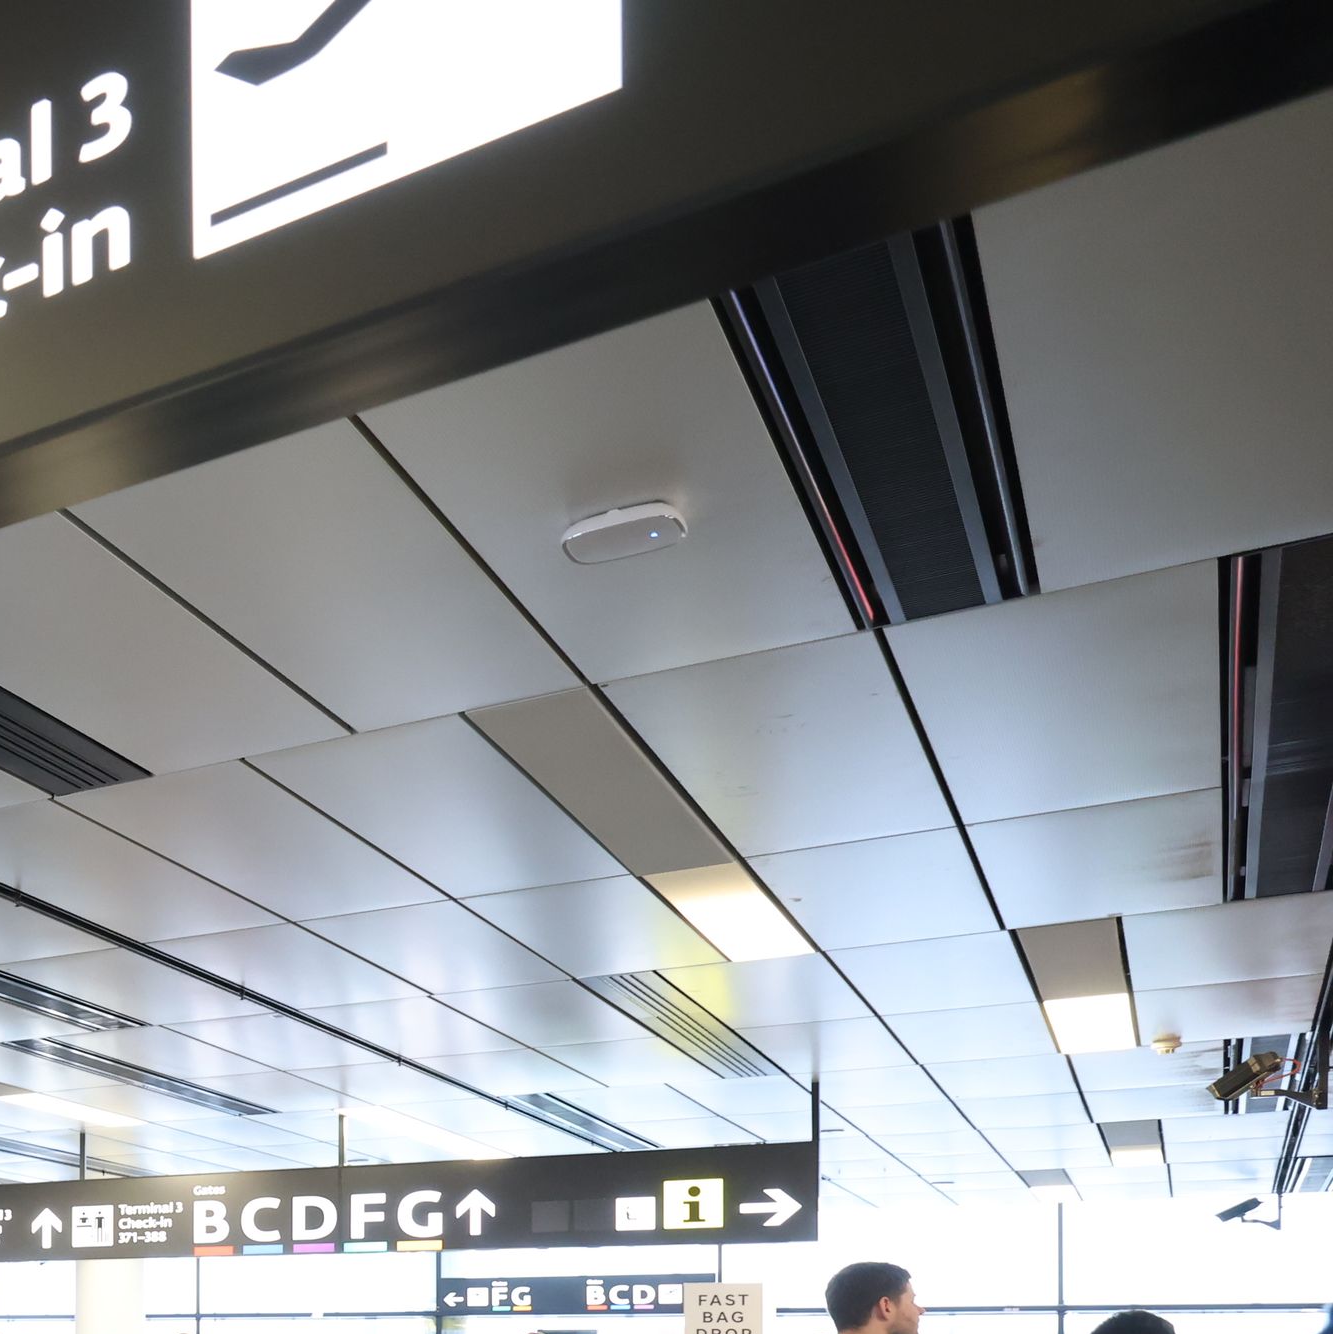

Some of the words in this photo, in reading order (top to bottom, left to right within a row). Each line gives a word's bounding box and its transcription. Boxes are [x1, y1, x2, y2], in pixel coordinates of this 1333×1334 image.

[77, 71, 132, 163] 3
[193, 1185, 226, 1196] Gates
[118, 1201, 174, 1215] Terminal
[175, 1201, 183, 1213] 3
[118, 1216, 173, 1229] Check-in
[698, 1294, 749, 1306] FAST
[702, 1311, 744, 1323] BAG
